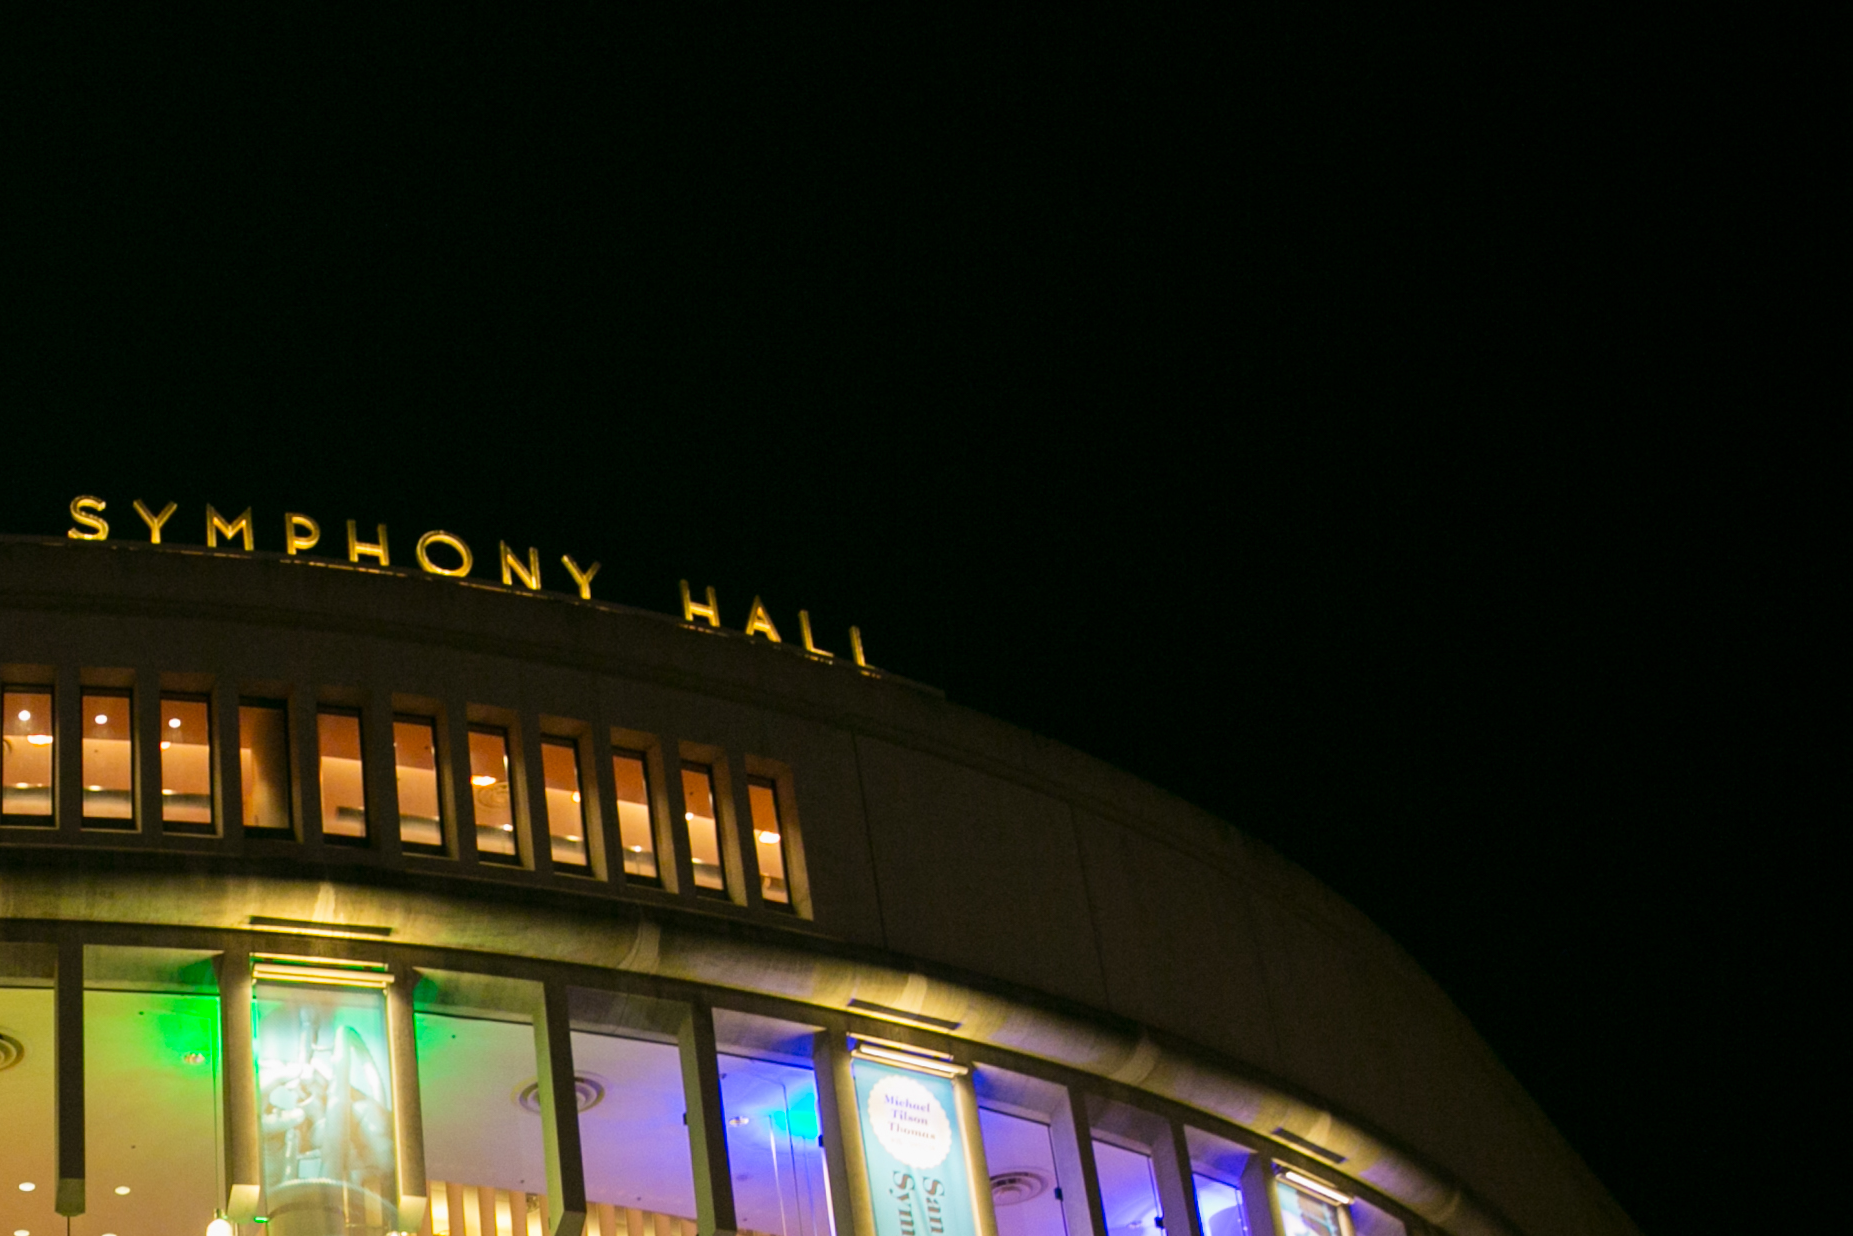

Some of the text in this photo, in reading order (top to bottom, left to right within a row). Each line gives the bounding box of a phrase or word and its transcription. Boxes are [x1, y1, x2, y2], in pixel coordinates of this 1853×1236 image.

[67, 493, 602, 600] SYMPHONY
[679, 579, 876, 670] HALL
[884, 1093, 931, 1113] Michael
[890, 1107, 929, 1126] Tilson
[888, 1120, 936, 1140] Thomas
[922, 1177, 945, 1234] San
